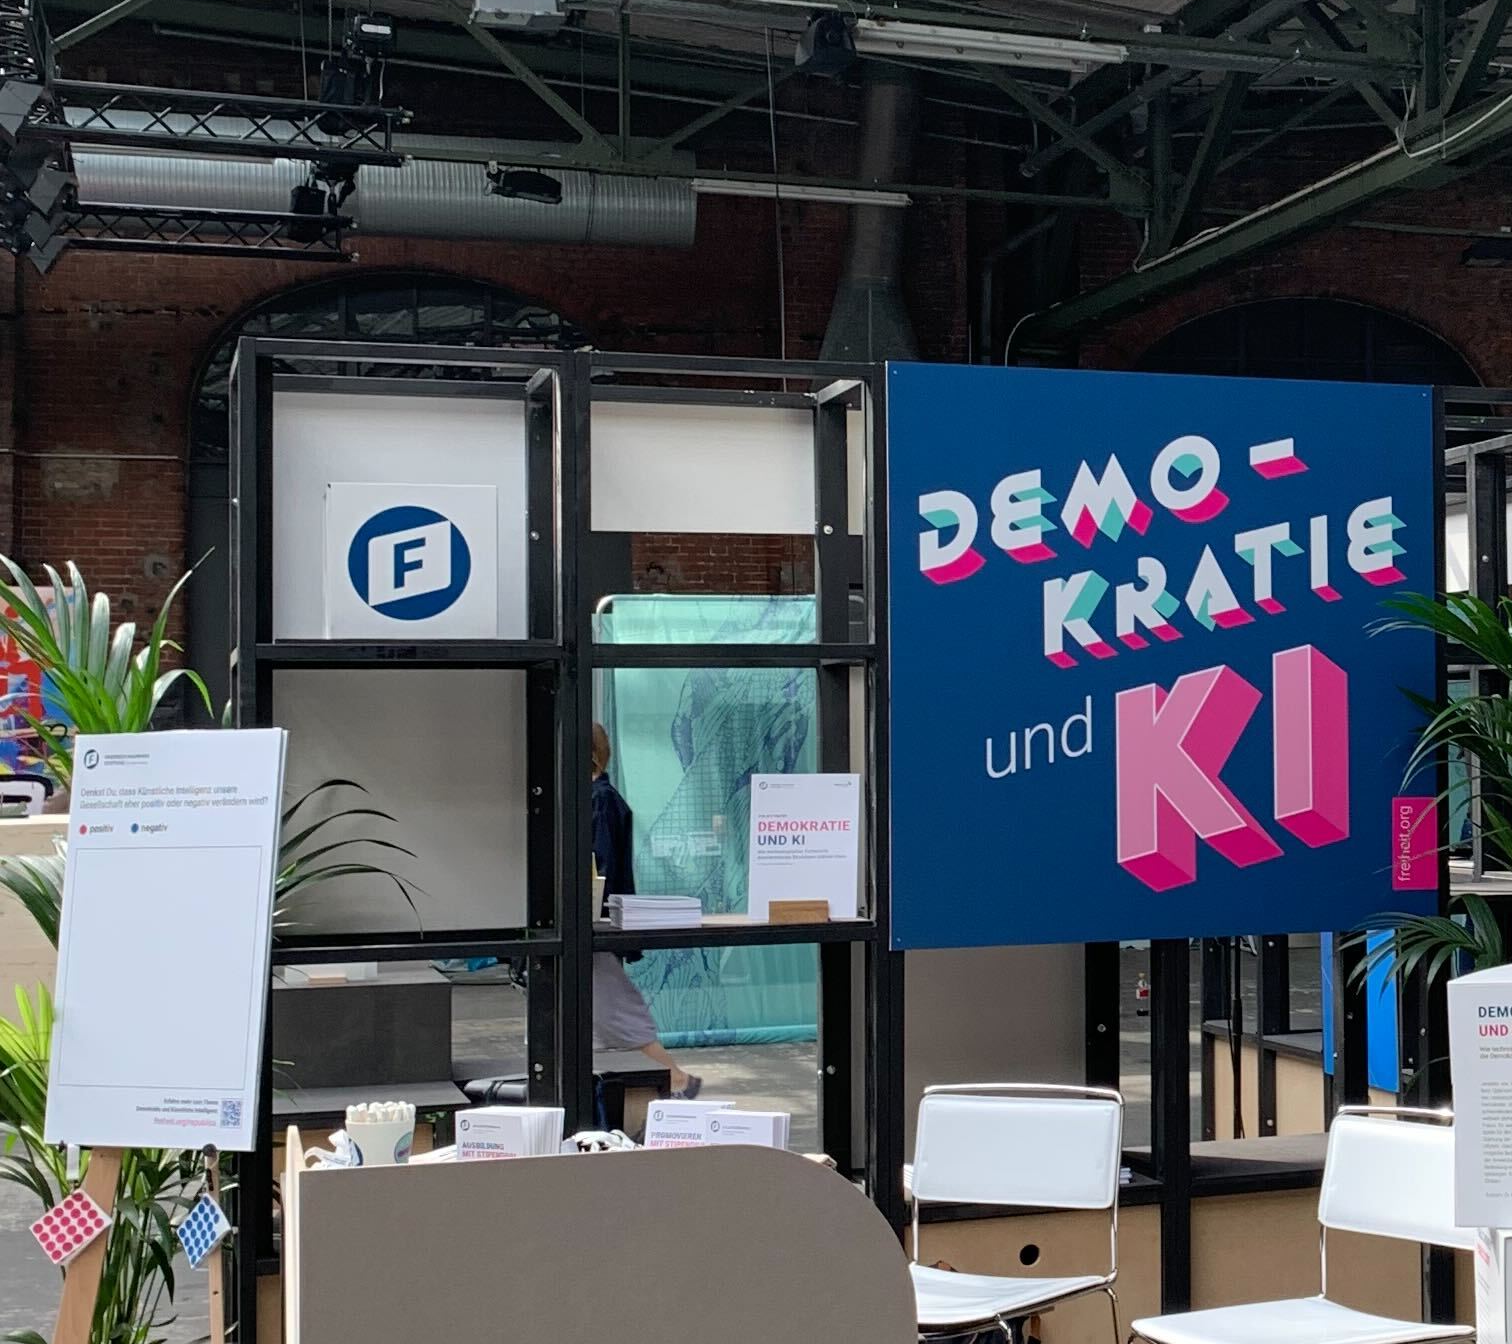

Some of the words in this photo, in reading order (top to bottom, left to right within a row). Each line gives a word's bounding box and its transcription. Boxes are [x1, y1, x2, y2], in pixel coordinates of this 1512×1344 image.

[1043, 496, 1407, 668] KRATIE
[985, 698, 1092, 778] und
[1115, 644, 1349, 892] KI
[758, 820, 851, 833] DEMOKRATIE
[758, 835, 788, 846] UND
[792, 834, 805, 846] KI
[1479, 1025, 1509, 1037] UND
